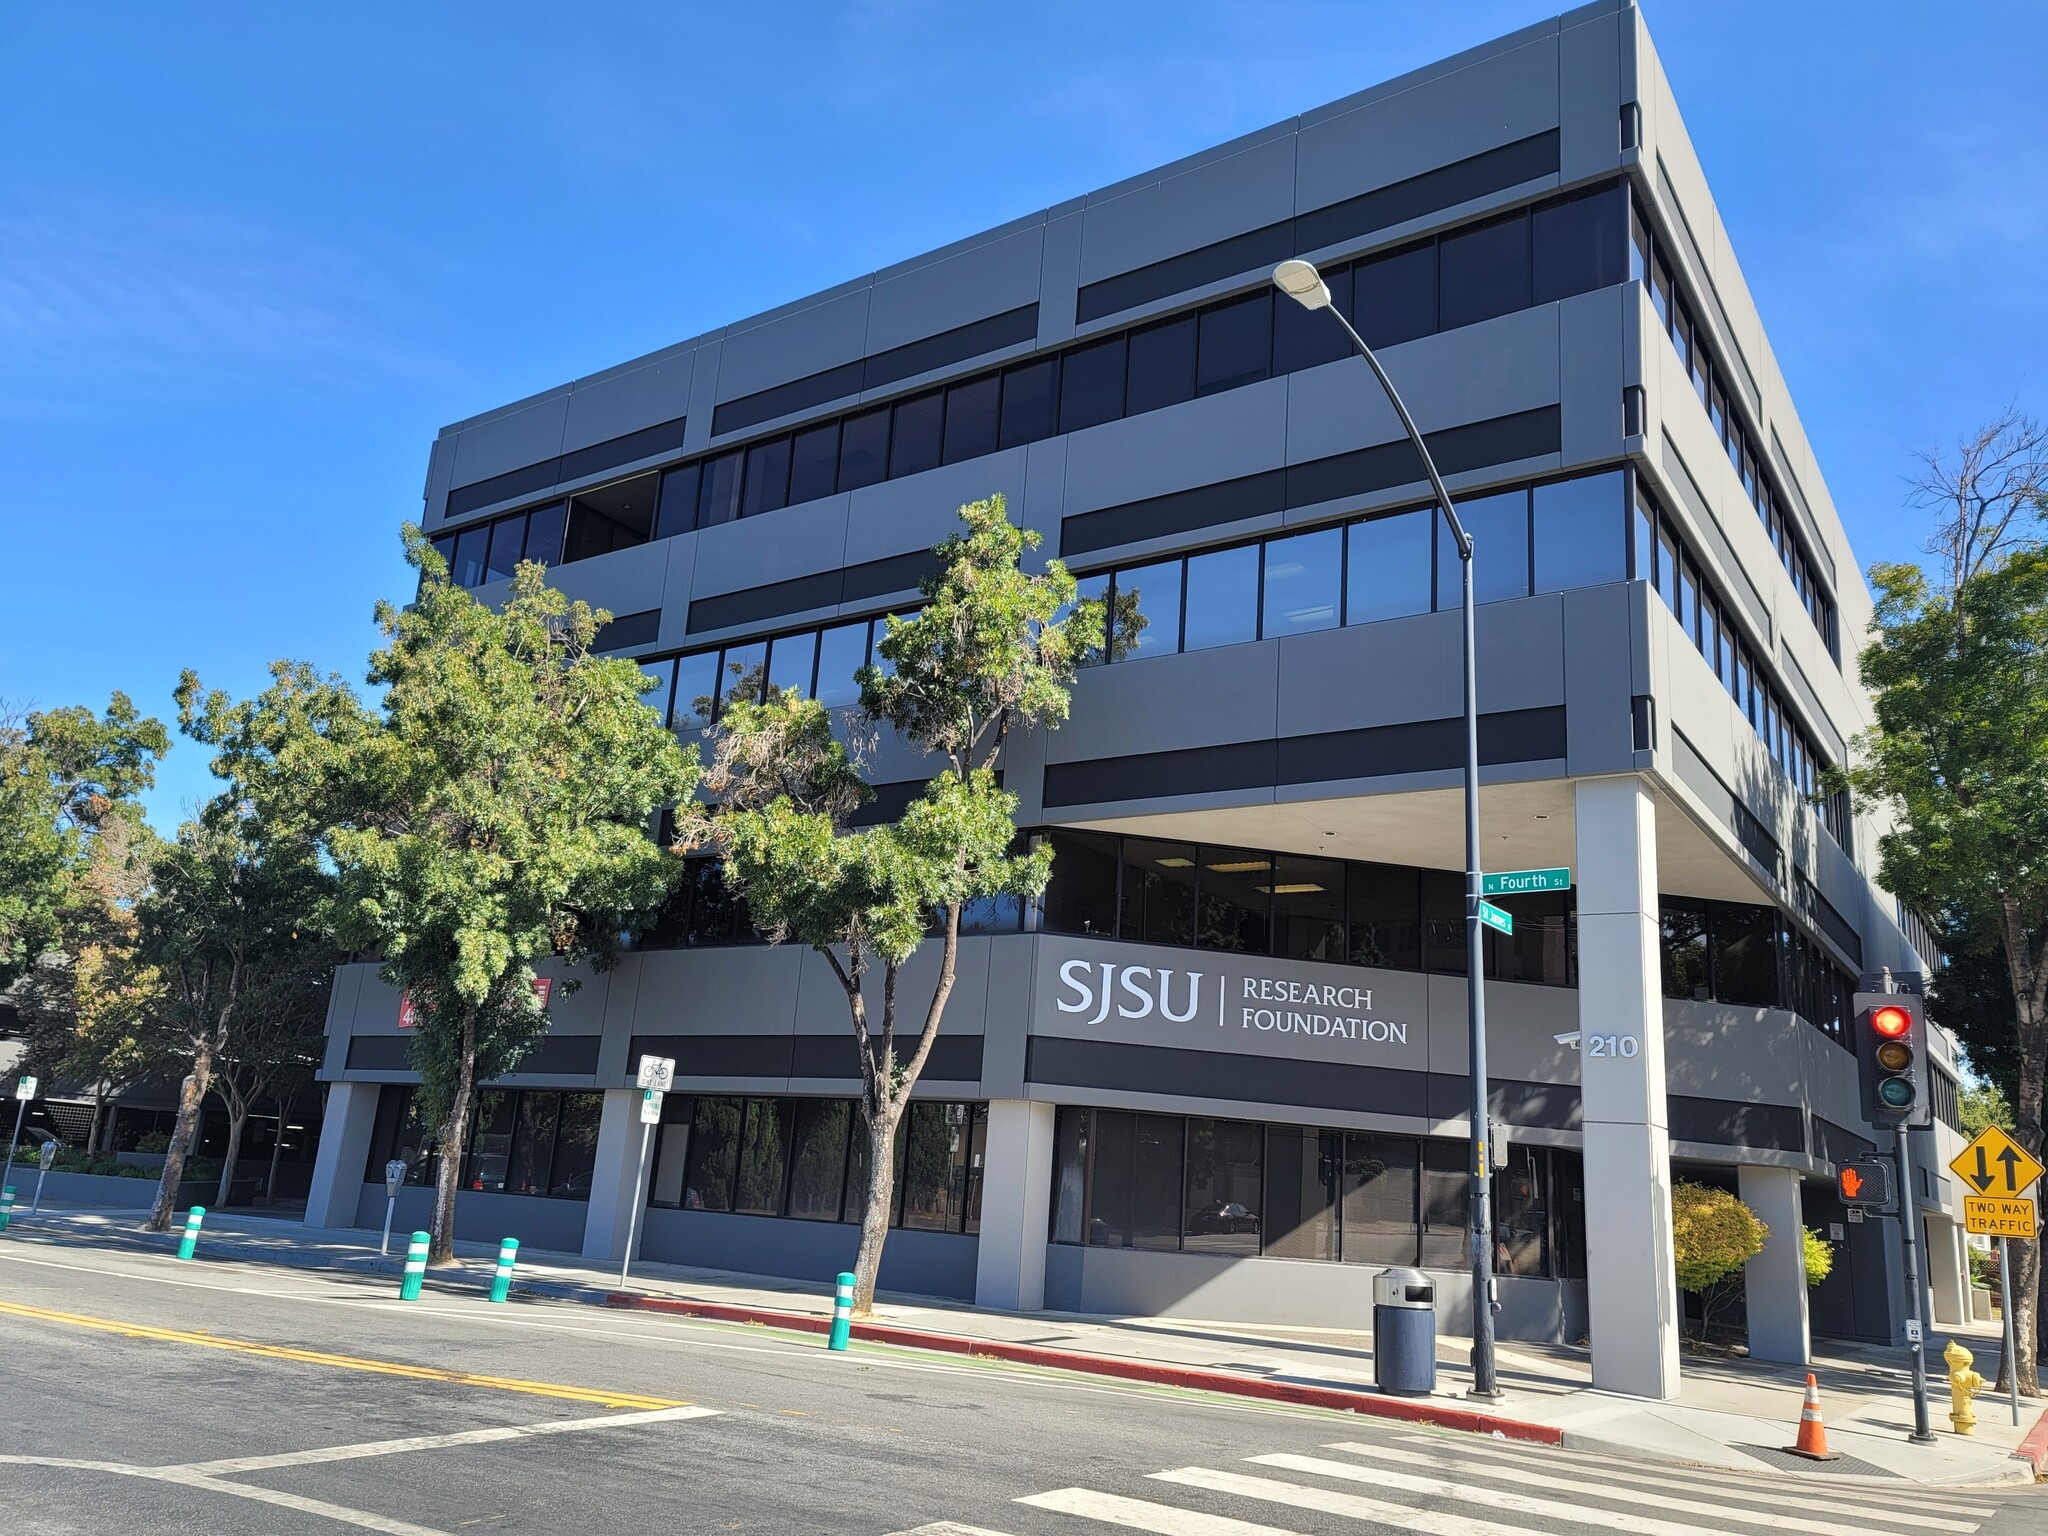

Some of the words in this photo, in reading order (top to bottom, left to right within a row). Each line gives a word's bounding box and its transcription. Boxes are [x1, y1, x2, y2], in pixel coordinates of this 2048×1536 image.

[1488, 883, 1494, 891] N
[1500, 874, 1547, 890] Fourth
[1554, 878, 1563, 886] St
[1056, 959, 1204, 1025] SJSU
[1242, 977, 1373, 1011] RESEARCH
[1241, 1007, 1408, 1044] FOUNDATION
[1589, 1035, 1639, 1058] 210
[1968, 1201, 1996, 1214] TWO
[2001, 1203, 2029, 1215] WAY
[1969, 1217, 2031, 1232] TRAFFIC
